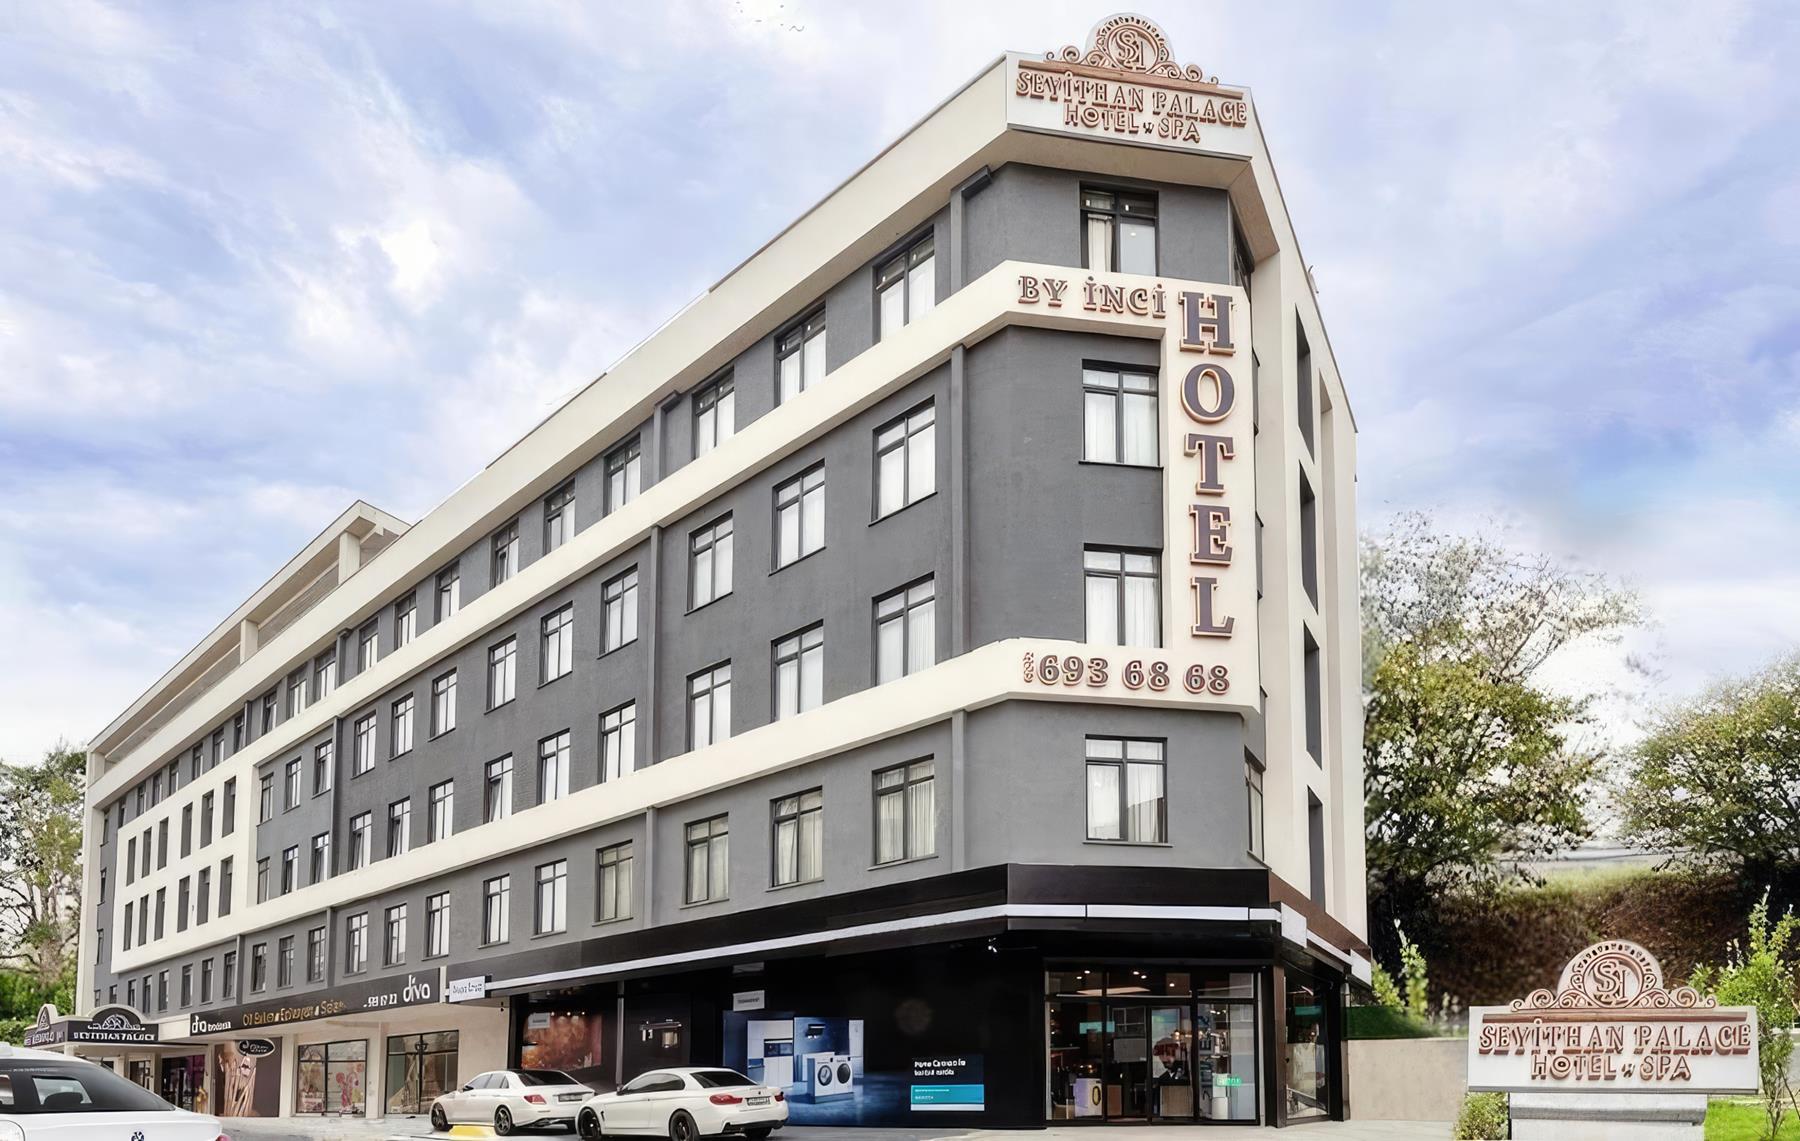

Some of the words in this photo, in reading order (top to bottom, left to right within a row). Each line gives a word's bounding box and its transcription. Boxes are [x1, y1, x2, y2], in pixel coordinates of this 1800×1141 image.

[1016, 70, 1144, 112] SEYİTHAN
[1152, 91, 1247, 128] PALACE
[1065, 103, 1139, 133] HOTEL
[1158, 117, 1200, 143] SPA
[1018, 275, 1067, 307] BY
[1179, 291, 1236, 639] HOTEL
[1037, 654, 1109, 688] 693
[1122, 660, 1170, 691] 68
[1183, 664, 1231, 695] 68
[1478, 1018, 1624, 1055] SEYİTHAN
[1634, 1024, 1751, 1056] PALACE
[1531, 1055, 1617, 1081] HOTEL
[1640, 1055, 1692, 1081] SPA
